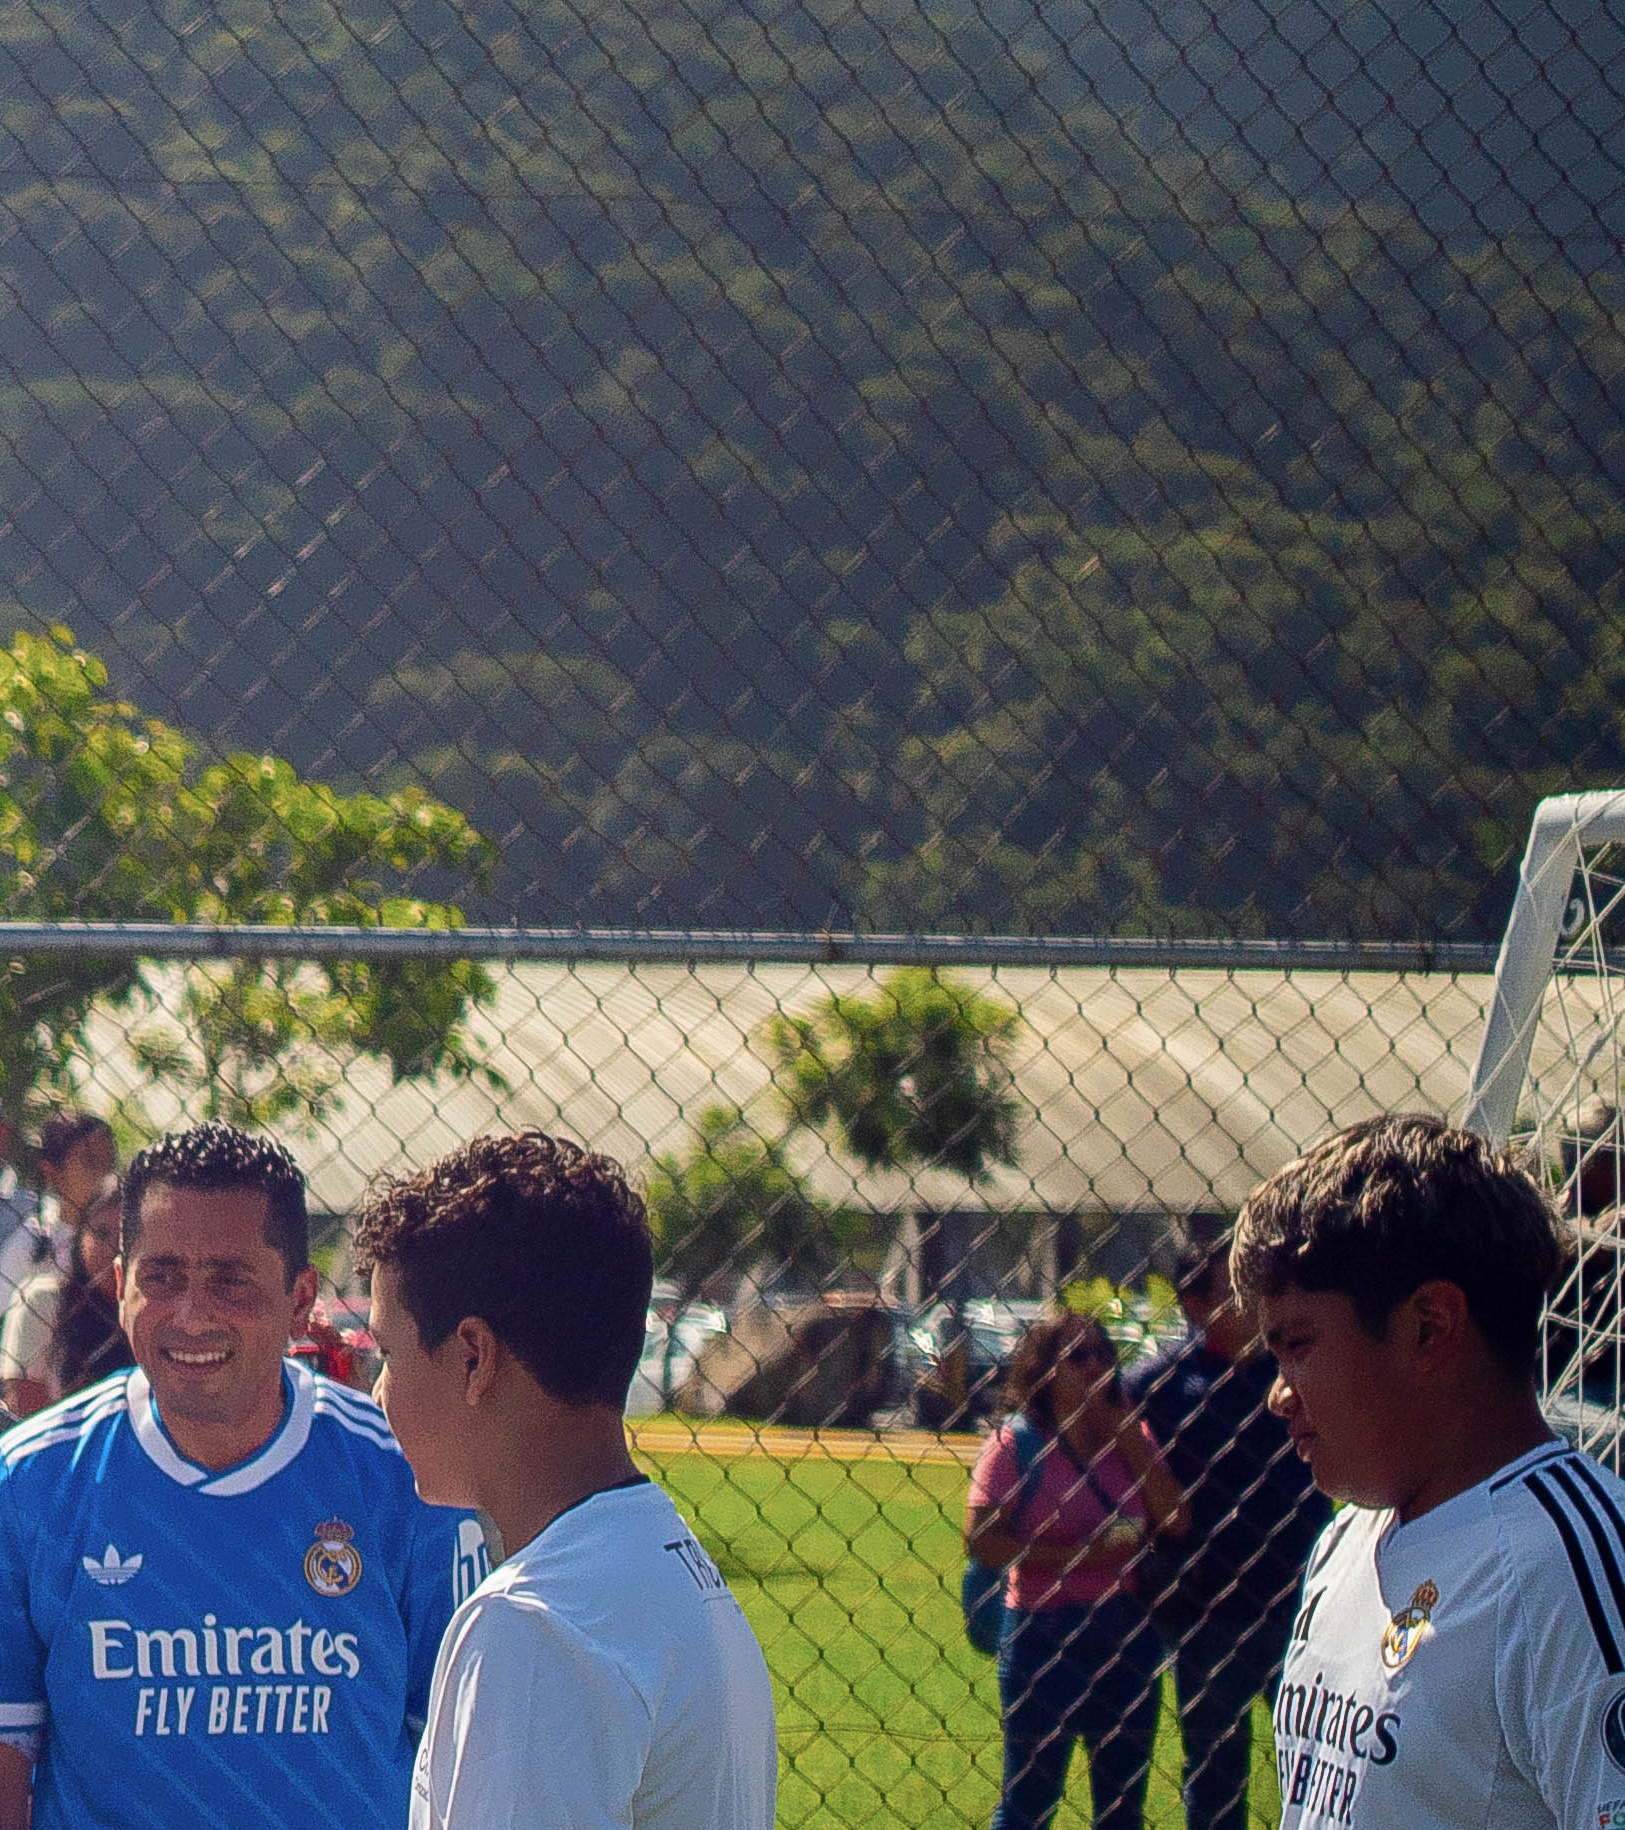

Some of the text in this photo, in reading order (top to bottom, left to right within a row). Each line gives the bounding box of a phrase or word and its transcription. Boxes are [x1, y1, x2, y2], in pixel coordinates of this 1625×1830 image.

[88, 1613, 360, 1680] Emirates
[135, 1685, 331, 1736] FLY BETTER
[1275, 1671, 1401, 1766] mirates
